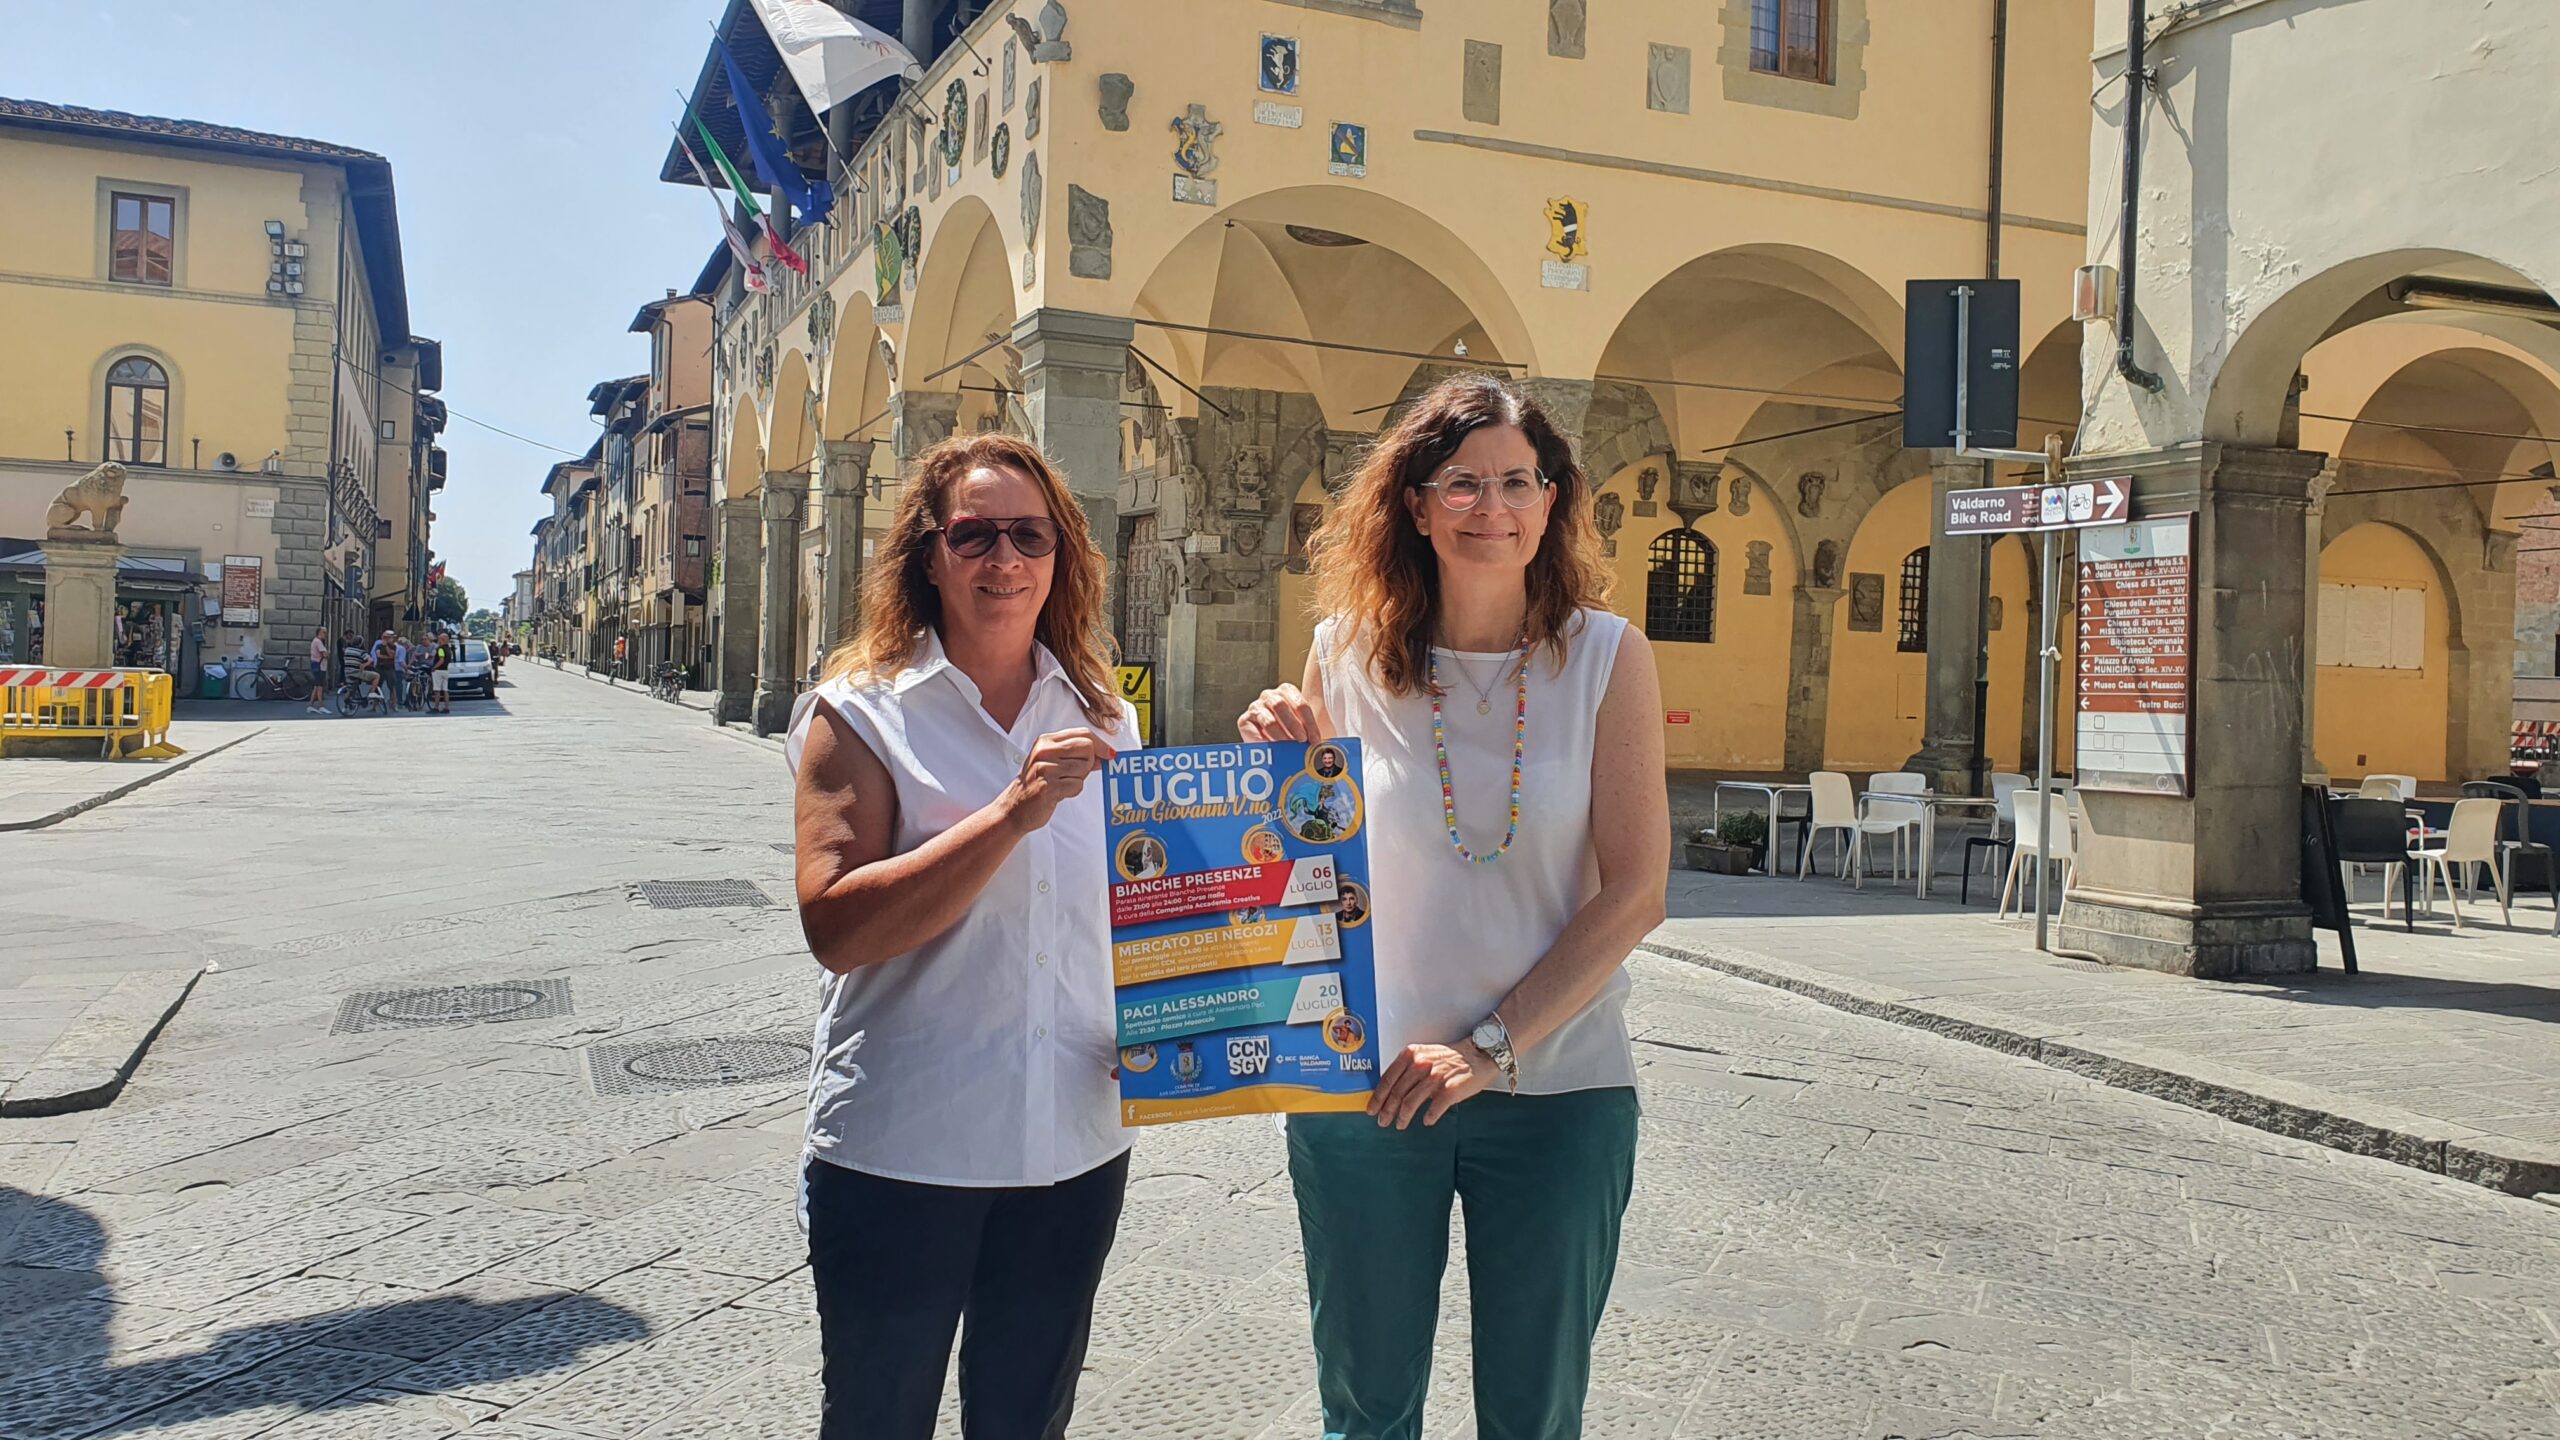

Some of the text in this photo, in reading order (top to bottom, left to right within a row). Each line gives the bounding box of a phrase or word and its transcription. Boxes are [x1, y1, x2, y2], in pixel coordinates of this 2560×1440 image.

[1952, 497, 2005, 510] Valdarno
[1951, 510, 2012, 524] Bike Road
[2094, 562, 2117, 570] Basilica
[2125, 561, 2144, 569] Museo
[2154, 558, 2171, 566] Maria
[2114, 569, 2136, 577] Grazie
[2116, 581, 2139, 589] Chiesa
[2104, 600, 2127, 608] Chiesa
[2149, 598, 2171, 606] Anime
[2104, 608, 2140, 618] Purgatorio
[2107, 619, 2130, 627] Chiesa
[2166, 618, 2184, 626] Lucia
[2110, 637, 2184, 646] Biblioteca Comunale
[2094, 656, 2119, 664] Palazzo
[2094, 666, 2136, 674] MUNICIPIO
[2094, 681, 2116, 689] Museo
[2118, 681, 2135, 689] Casa
[2151, 681, 2185, 689] Masaccio
[2137, 700, 2185, 709] Teatro Bucci
[1108, 745, 1272, 775] MERCOLEDÌ DI
[1110, 768, 1274, 811] LUGLIO
[1111, 794, 1273, 826] San Giovanni V.no
[1261, 808, 1284, 825] 2022
[1312, 866, 1332, 879] 06
[1116, 867, 1262, 897] BIANCHE PRESENZE
[1290, 880, 1333, 893] LUGLIO
[1116, 898, 1136, 906] Parata
[1170, 889, 1195, 898] Bianche
[1196, 884, 1226, 894] Presenze
[1156, 904, 1193, 915] Compagnia
[1195, 899, 1232, 909] Accademia
[1233, 895, 1260, 904] Creativa
[1318, 924, 1333, 935] 13
[1119, 924, 1278, 958] MERCATO DEI NEGOZI
[1291, 937, 1334, 950] LUGLIO
[1132, 953, 1170, 964] pomeriggio
[1320, 985, 1338, 997] 20
[1123, 988, 1260, 1020] PACI ALESSANDRO
[1296, 999, 1340, 1011] LUGLIO
[1125, 1018, 1161, 1030] Spettacolo
[1162, 1014, 1186, 1023] comico
[1139, 1026, 1156, 1035] 21:30
[1161, 1022, 1183, 1031] Piazza
[1184, 1016, 1215, 1027] Masaccio
[1229, 1040, 1267, 1058] CCN
[1229, 1058, 1268, 1076] SGV
